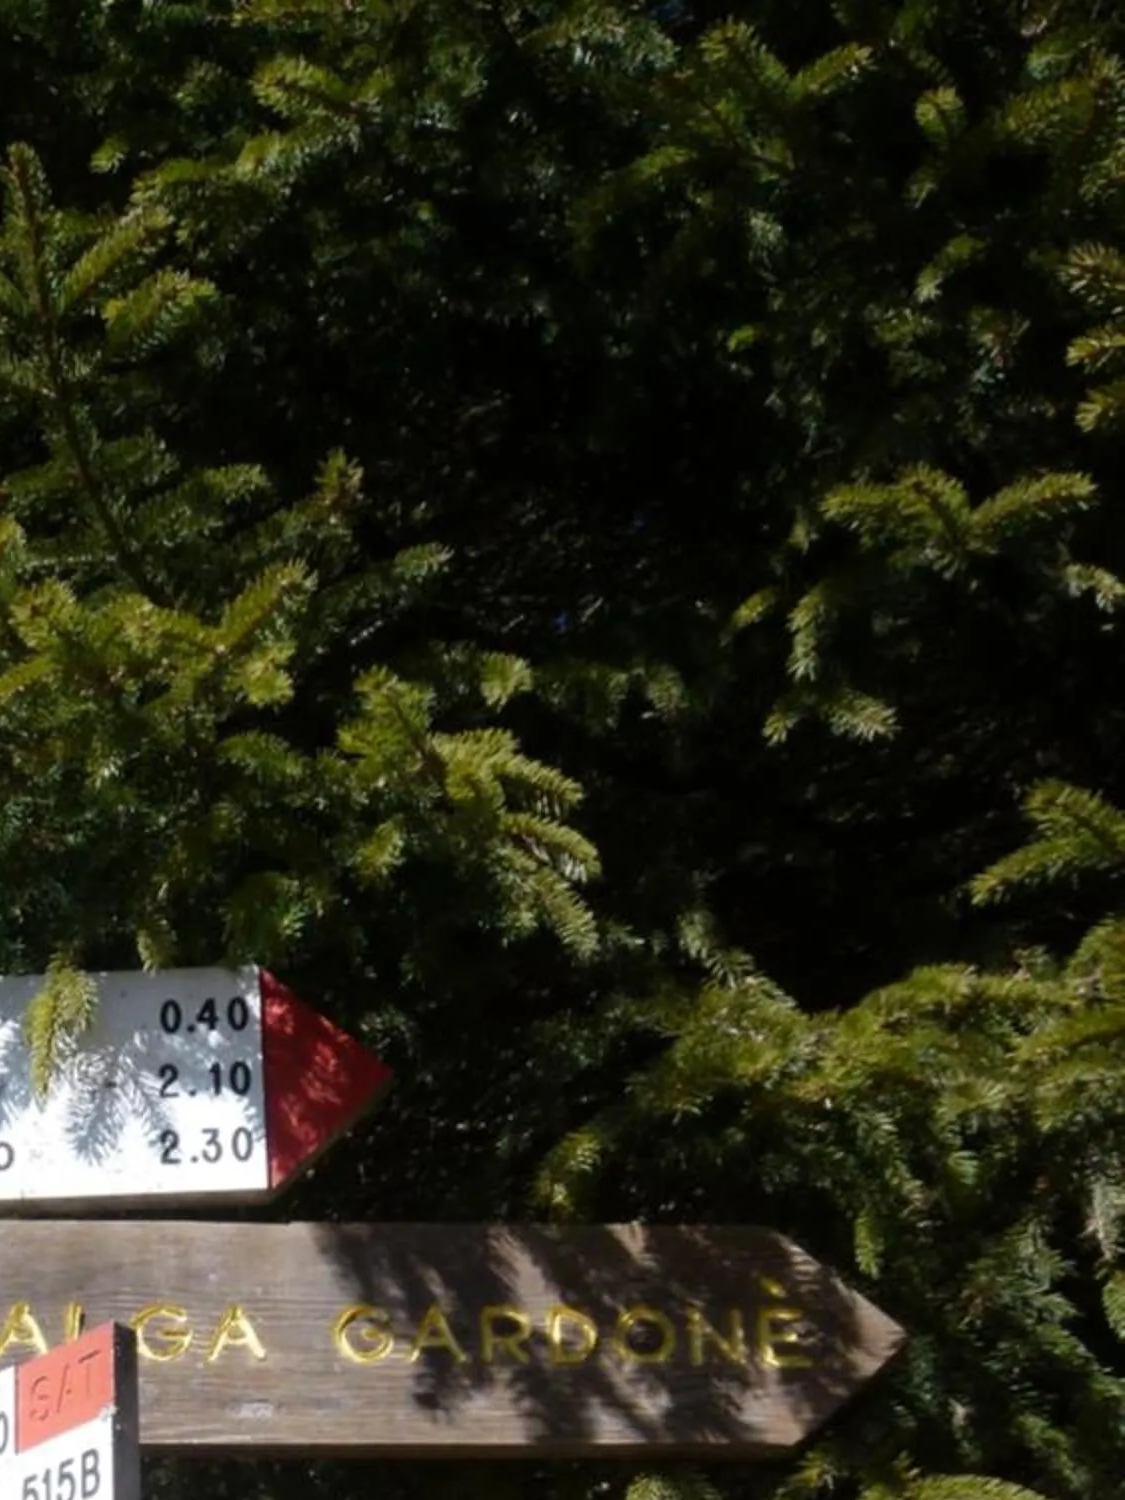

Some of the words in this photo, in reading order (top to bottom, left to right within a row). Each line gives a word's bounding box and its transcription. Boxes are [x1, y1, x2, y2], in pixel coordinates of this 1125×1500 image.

[159, 997, 250, 1034] 0.40
[158, 1061, 252, 1099] 2.10
[159, 1127, 254, 1166] 2.30
